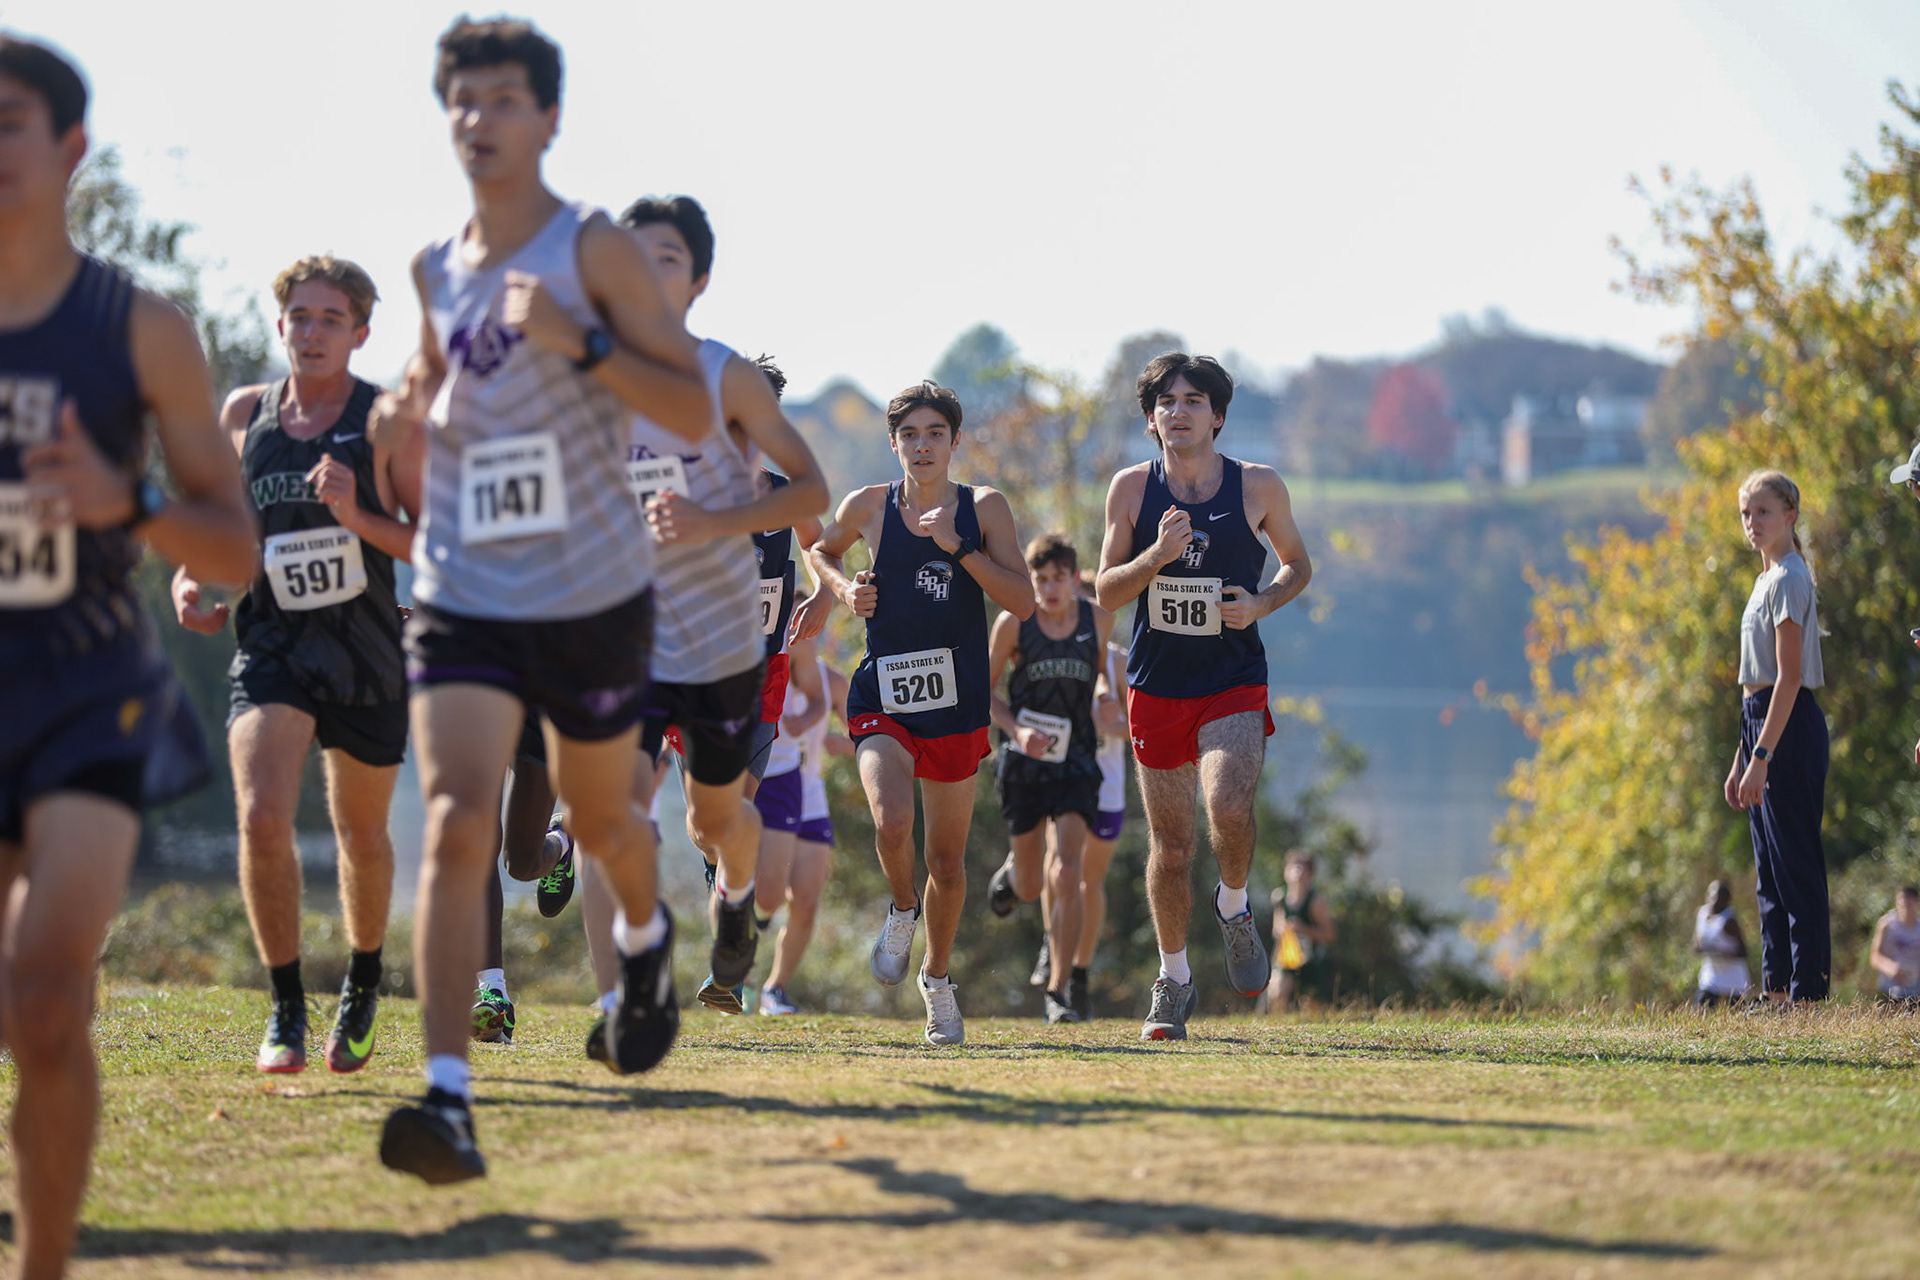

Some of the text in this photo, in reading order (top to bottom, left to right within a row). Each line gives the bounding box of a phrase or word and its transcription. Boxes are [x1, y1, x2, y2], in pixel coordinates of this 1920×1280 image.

[252, 471, 322, 510] WE
[473, 474, 543, 523] 1147
[308, 538, 335, 551] STATE
[283, 556, 345, 598] 597
[917, 570, 948, 599] SBA
[1156, 582, 1214, 594] TSSAA STATE XC
[1161, 598, 1207, 627] 518
[885, 655, 945, 672] TSSAA STATE XC
[891, 672, 945, 705] 520
